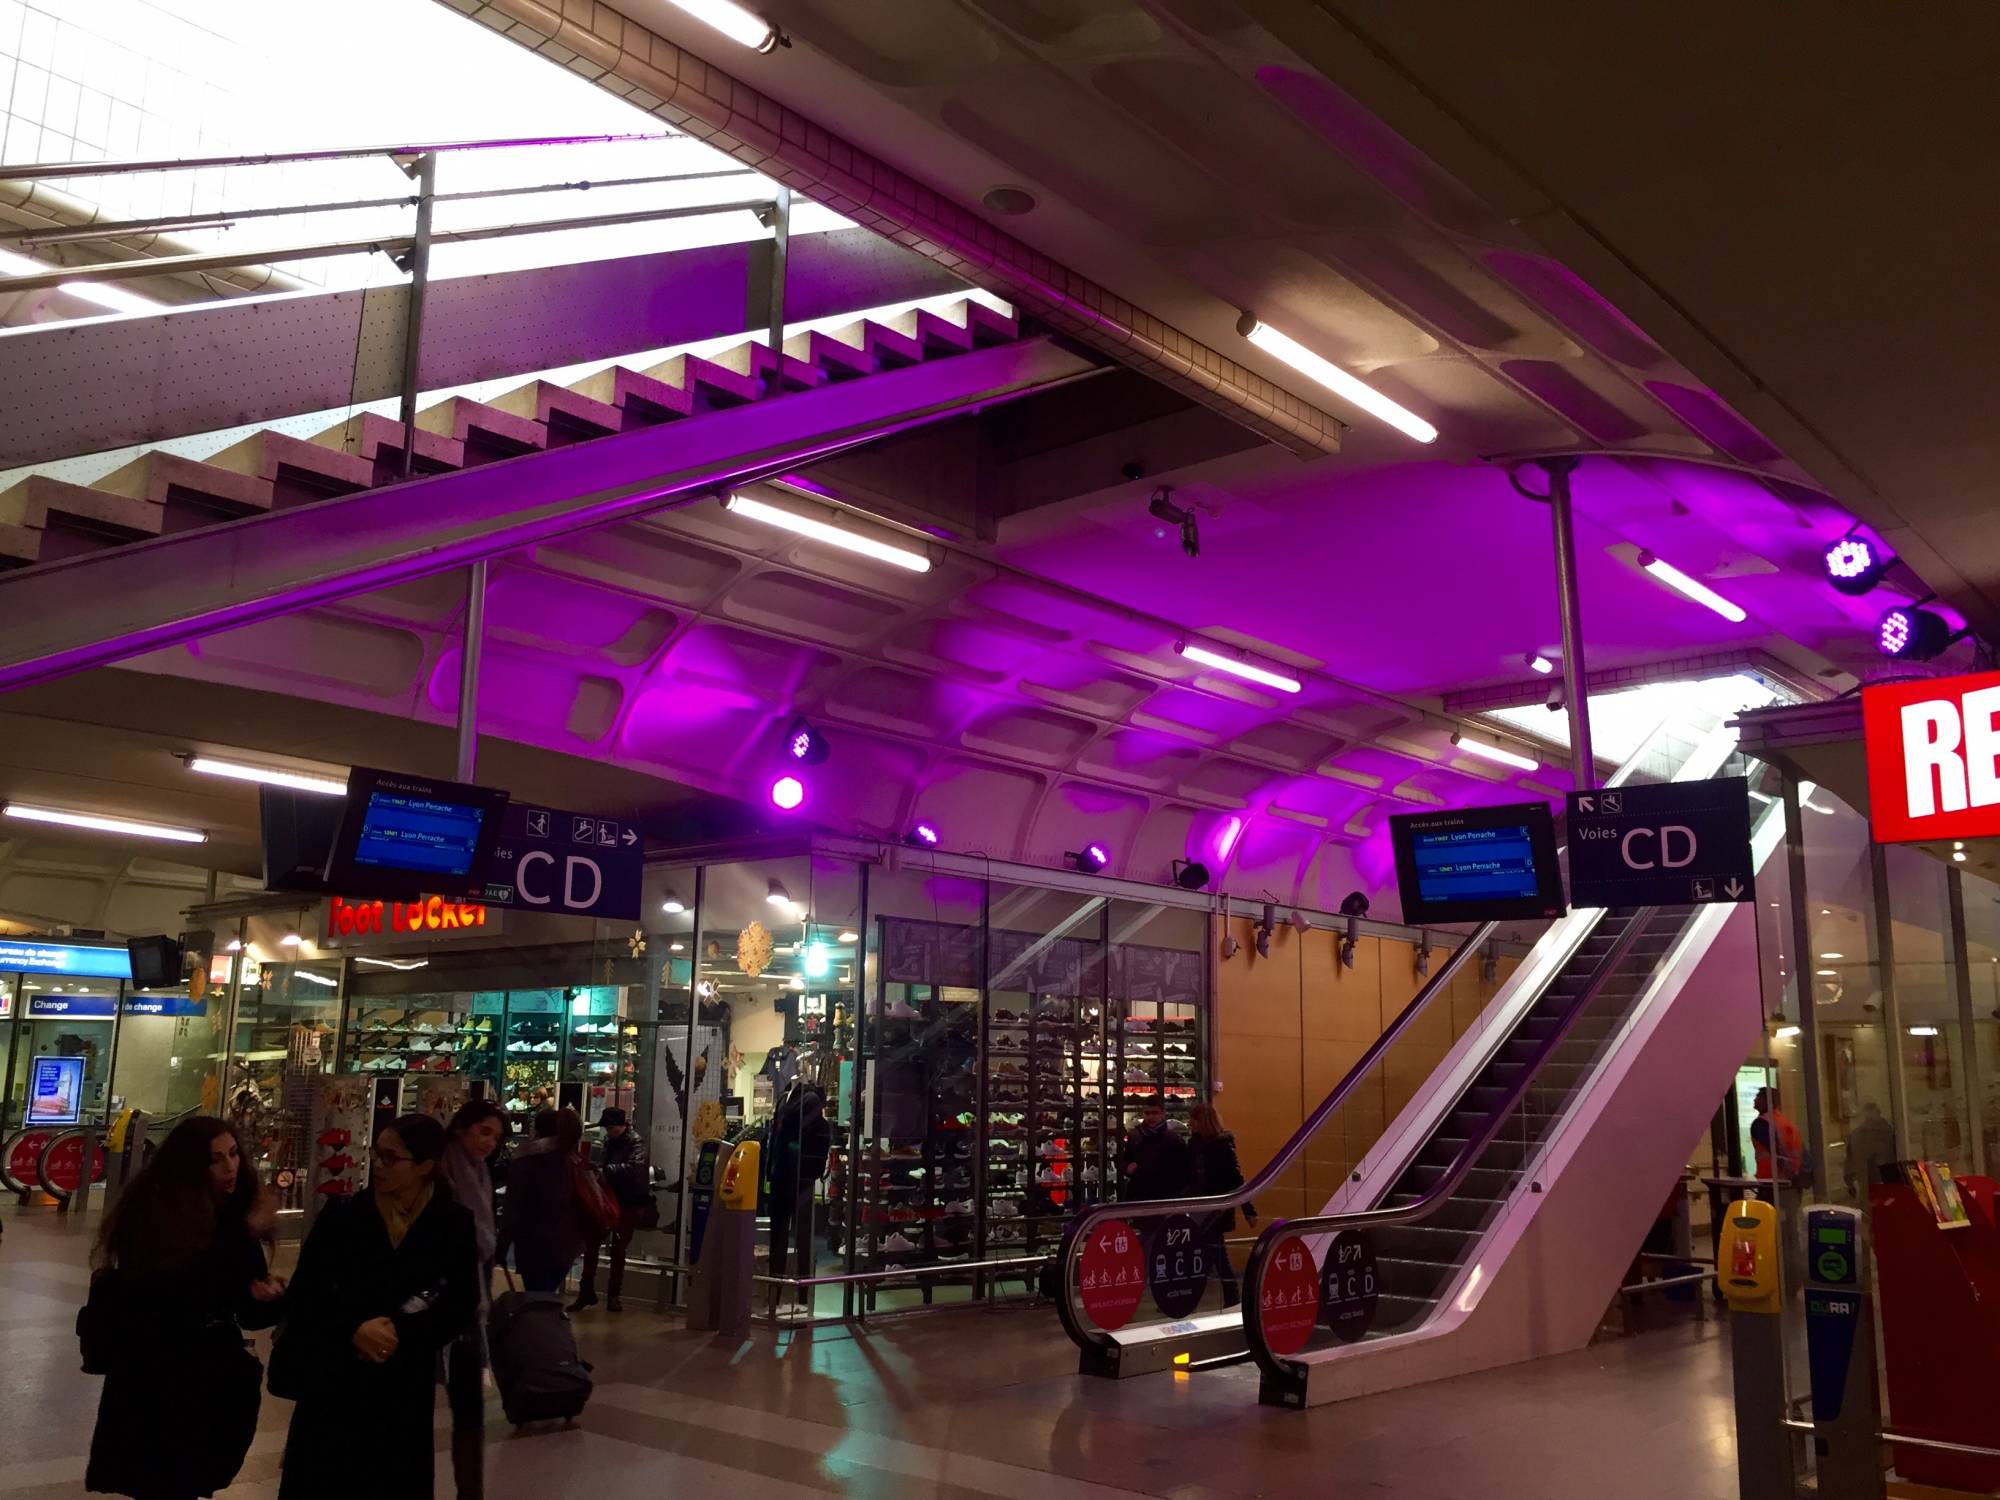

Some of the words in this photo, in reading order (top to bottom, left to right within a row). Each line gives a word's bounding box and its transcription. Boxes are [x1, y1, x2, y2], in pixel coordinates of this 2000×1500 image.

[376, 778, 398, 790] Accès
[412, 784, 433, 794] trains
[408, 798, 424, 808] Lyon
[425, 801, 453, 813] Perrache
[1409, 821, 1429, 829] Accès
[1444, 819, 1464, 827] trains
[400, 830, 417, 840] Lyon
[418, 832, 445, 843] Perrache
[1450, 832, 1467, 842] Lyon
[1468, 831, 1496, 840] Perrache
[1578, 826, 1617, 841] Voies
[494, 846, 513, 860] ies
[1622, 825, 1697, 870] CD
[1455, 863, 1472, 873] Lyon
[1473, 861, 1501, 870] Perrache
[516, 850, 602, 909] CD
[328, 896, 383, 938] Foot
[392, 896, 487, 932] Locker
[34, 1000, 68, 1011] Change
[134, 1002, 163, 1013] change
